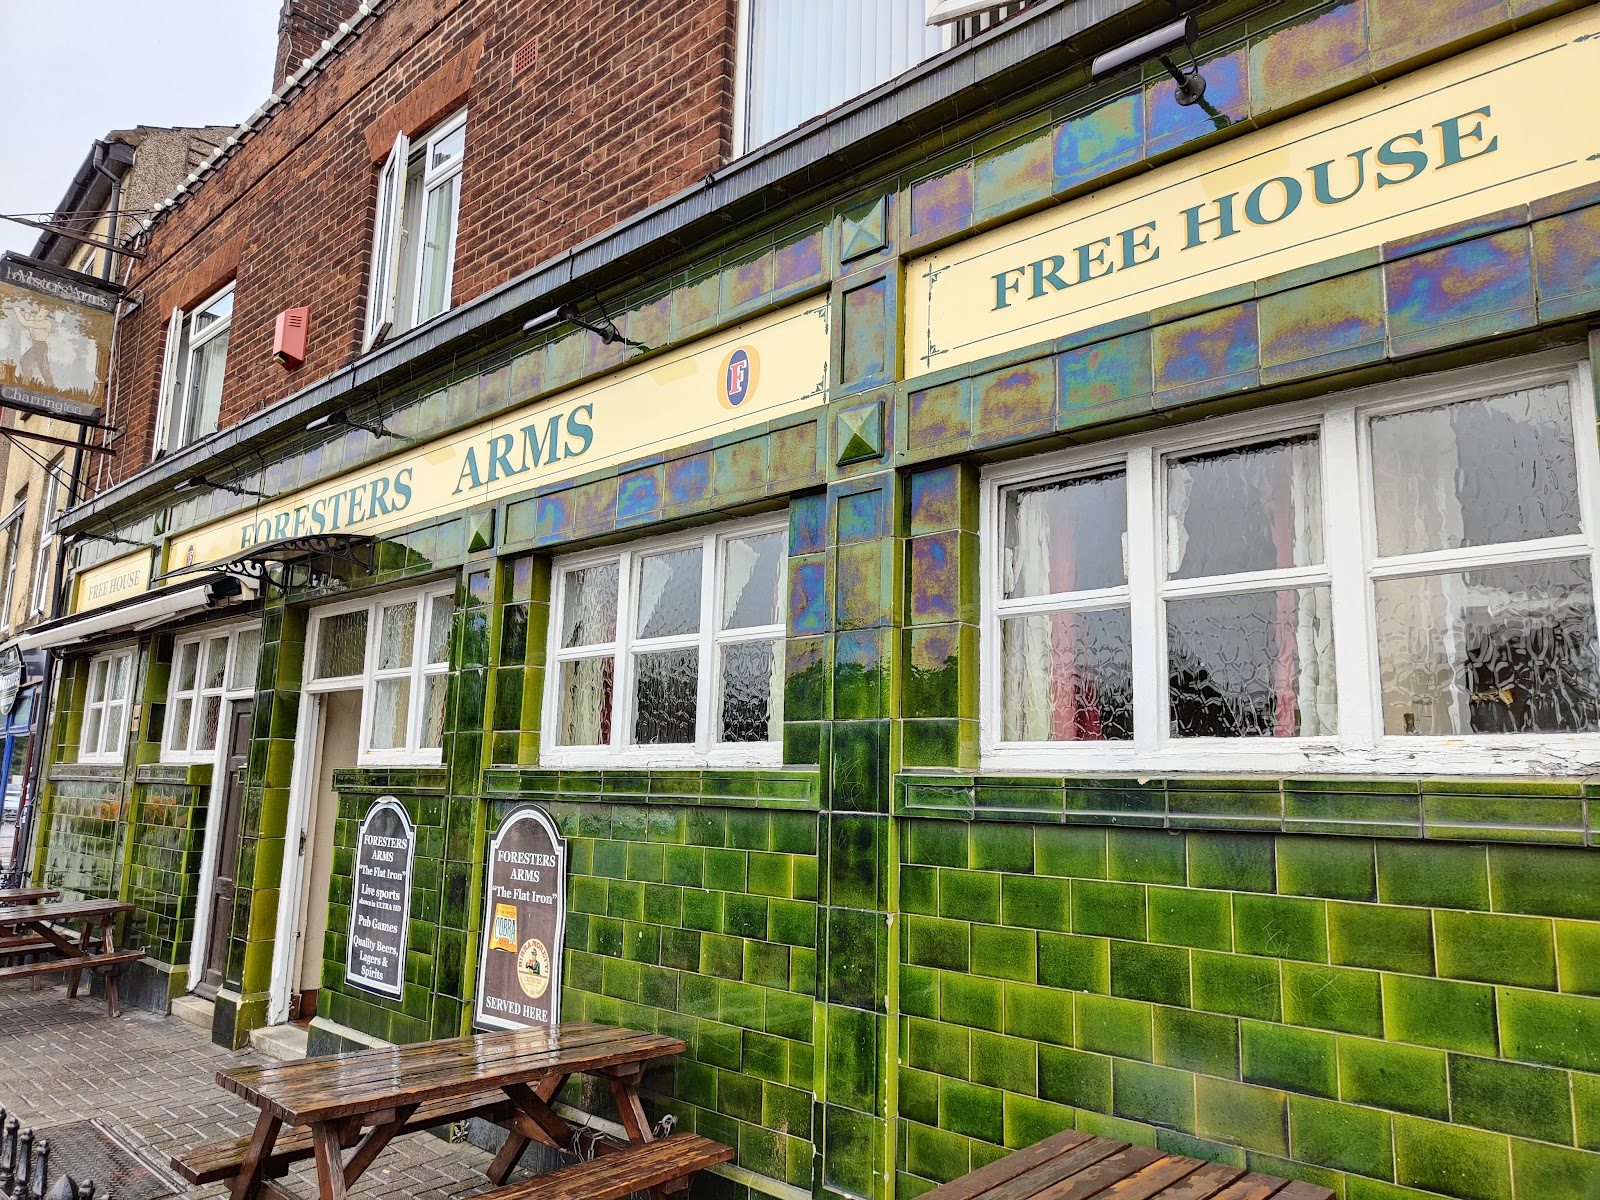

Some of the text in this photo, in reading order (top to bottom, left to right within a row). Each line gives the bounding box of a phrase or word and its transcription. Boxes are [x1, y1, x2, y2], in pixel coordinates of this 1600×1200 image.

[989, 105, 1499, 313] FREE HOUSE
[1, 386, 82, 415] Charrington
[240, 402, 594, 550] FORESTERS ARMS
[88, 569, 141, 600] FREE HOUSE
[363, 834, 408, 850] FORESTERS
[371, 850, 394, 863] ARMS
[497, 850, 556, 868] FORESTERS
[373, 866, 386, 878] Flat
[509, 868, 540, 883] ARMS
[361, 883, 401, 901] Live sports
[513, 888, 530, 902] Flat
[358, 897, 402, 912] shown in ULTRA HD
[357, 914, 398, 934] Pub Games
[495, 916, 516, 944] COBRA
[353, 935, 399, 957] Quality Beers,
[359, 950, 388, 967] Lagers &
[518, 940, 549, 974] BIRRA MORETTI
[360, 964, 384, 980] Spirits
[486, 995, 549, 1023] SERVED HERE
